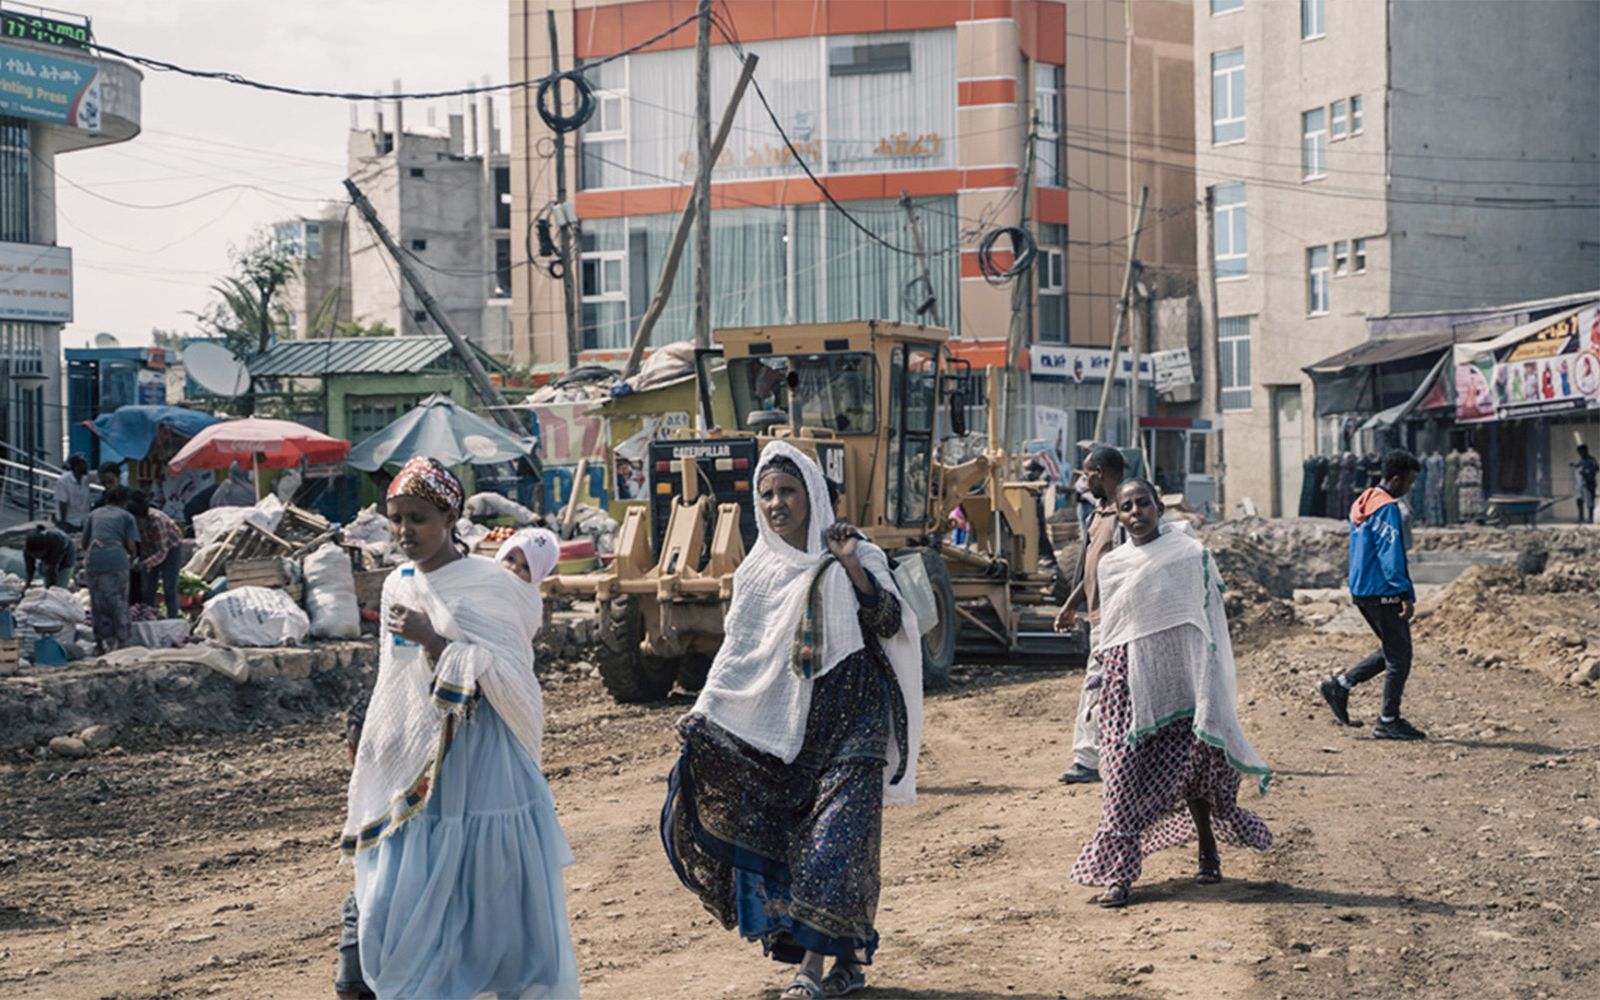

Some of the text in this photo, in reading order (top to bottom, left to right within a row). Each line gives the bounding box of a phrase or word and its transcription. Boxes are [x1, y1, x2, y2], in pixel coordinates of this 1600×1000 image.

[37, 87, 68, 105] Press
[673, 445, 730, 458] CATERPILLAR
[827, 448, 844, 484] CAT
